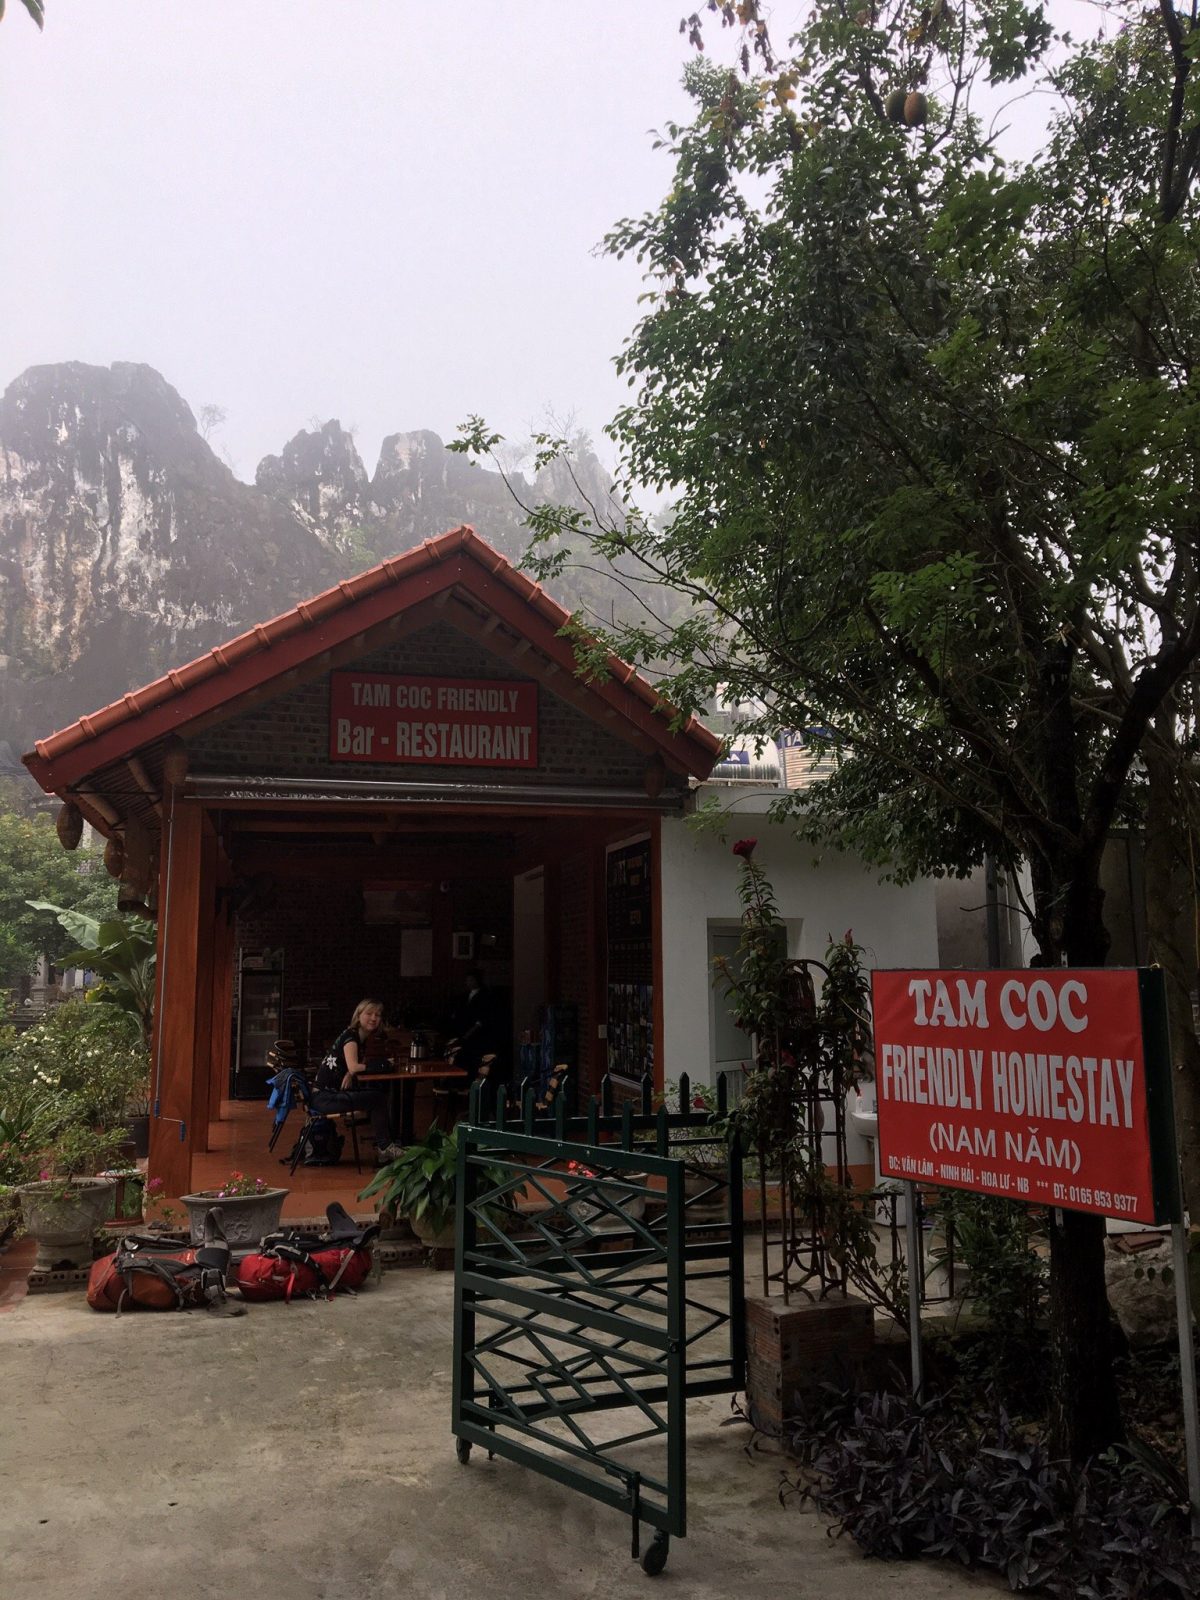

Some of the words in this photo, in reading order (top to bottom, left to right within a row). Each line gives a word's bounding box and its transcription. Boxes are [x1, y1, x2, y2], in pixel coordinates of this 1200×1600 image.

[352, 683, 391, 707] TAM
[396, 685, 431, 709] COC
[437, 687, 518, 713] FRIENDLY
[337, 719, 374, 755] Bar
[396, 721, 531, 760] RESTAURANT
[908, 979, 989, 1028] TAM
[1000, 979, 1088, 1033] COC
[882, 1043, 984, 1111] FRIENDLY
[991, 1050, 1135, 1129] HOMESTAY
[929, 1122, 997, 1159] (NAM
[1005, 1127, 1082, 1175] NĂM)
[917, 1160, 934, 1177] LÂM
[940, 1164, 960, 1182] NINH
[961, 1162, 975, 1184] HẢI
[981, 1171, 998, 1188] HOA
[1000, 1173, 1010, 1190] LƯ
[1017, 1177, 1029, 1194] NB
[1053, 1183, 1068, 1201] ĐT:
[1069, 1186, 1092, 1205] 0165
[1094, 1191, 1111, 1209] 953
[1113, 1195, 1138, 1213] 9377
